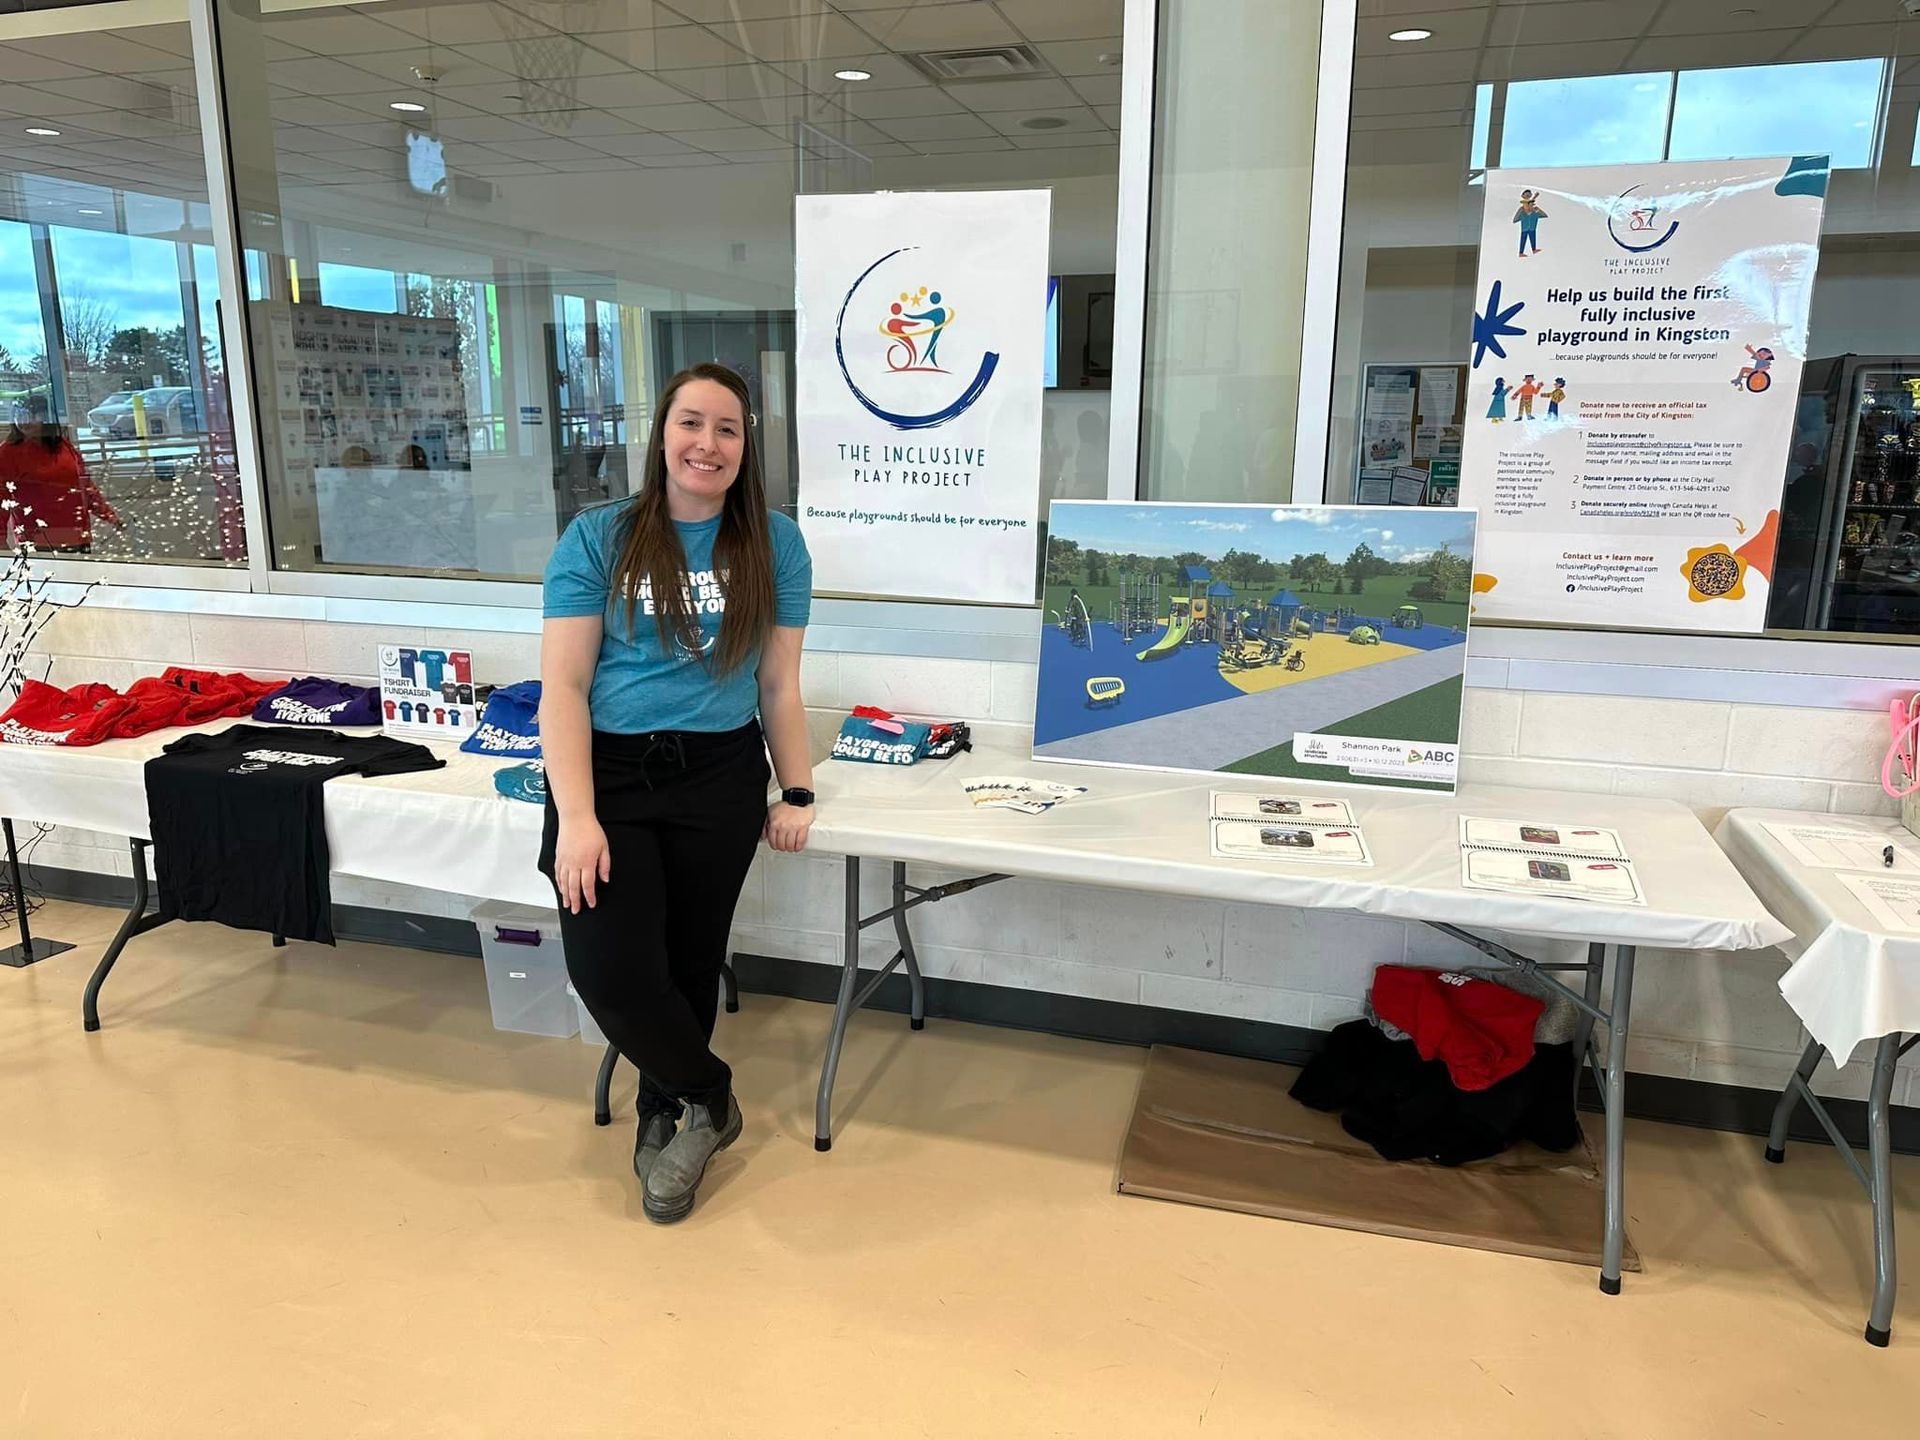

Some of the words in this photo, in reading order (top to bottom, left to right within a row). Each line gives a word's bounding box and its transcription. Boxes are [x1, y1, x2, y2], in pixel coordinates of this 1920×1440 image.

[1624, 258, 1670, 266] INCLUSIVE
[1547, 289, 1582, 305] Help
[1589, 291, 1607, 302] us
[1613, 287, 1654, 301] build
[1662, 287, 1687, 299] the
[1581, 308, 1617, 325] fully
[1623, 307, 1695, 321] inclusive
[1537, 328, 1628, 346] playground
[1635, 328, 1650, 341] in
[1657, 327, 1730, 344] Kingston
[1586, 353, 1629, 362] playgrounds
[1669, 401, 1693, 409] official
[1636, 412, 1649, 420] City
[1578, 431, 1583, 439] 1
[838, 444, 871, 462] THE
[884, 445, 985, 466] INCLUSIVE
[854, 469, 891, 483] PLAY
[903, 471, 971, 486] PROJECT
[1572, 475, 1579, 484] 2
[1571, 501, 1576, 510] 3
[807, 506, 847, 519] Because
[849, 509, 907, 525] playgrounds
[910, 513, 941, 523] should
[945, 514, 956, 524] be
[960, 515, 975, 527] for
[978, 518, 1027, 531] everyone
[1563, 552, 1591, 560] Contact
[1612, 553, 1631, 561] learn
[698, 584, 721, 600] BE
[384, 678, 410, 687] TSHIRT
[384, 687, 431, 697] FUNDRAISER
[275, 710, 331, 723] EVERYONE
[836, 733, 916, 752] LAYGROUND
[1342, 742, 1379, 751] Shannon
[1382, 744, 1401, 753] Park
[873, 750, 890, 762] BE
[894, 754, 914, 764] FO
[1424, 750, 1454, 763] ABC
